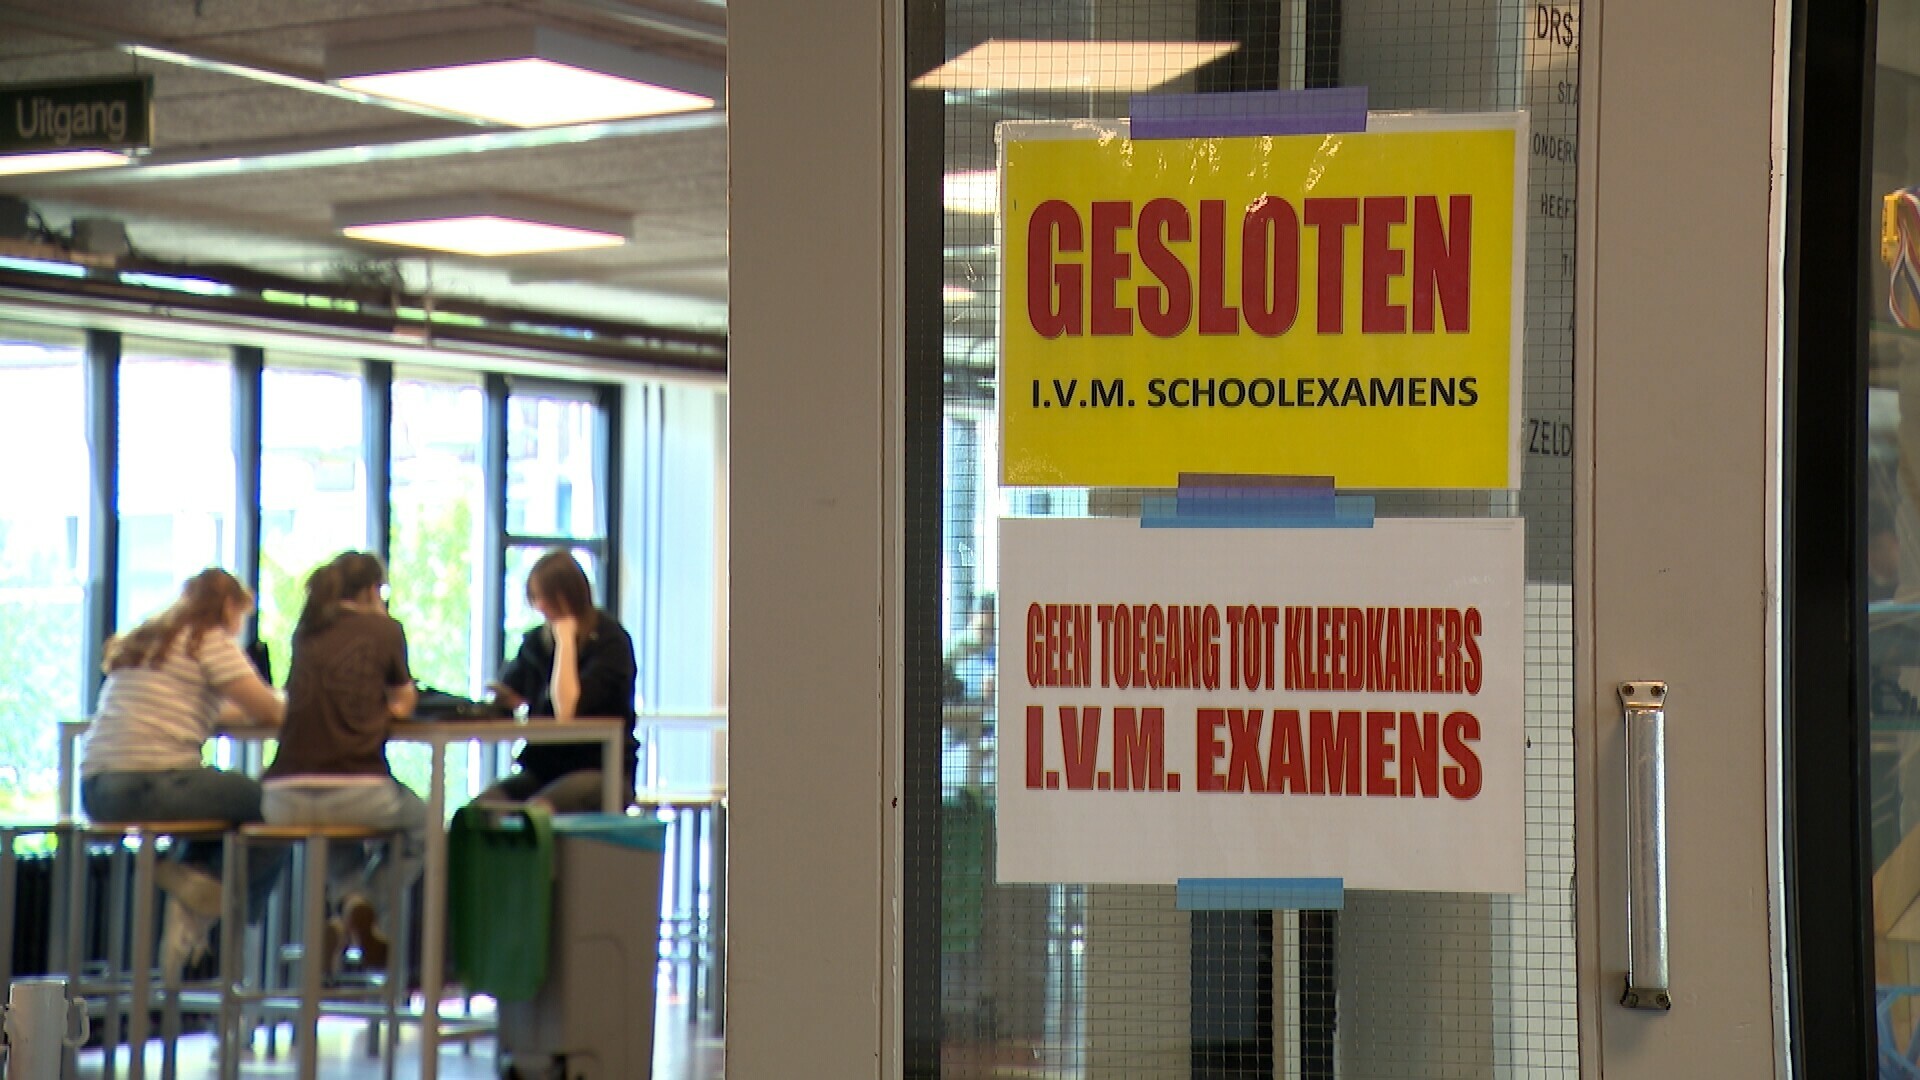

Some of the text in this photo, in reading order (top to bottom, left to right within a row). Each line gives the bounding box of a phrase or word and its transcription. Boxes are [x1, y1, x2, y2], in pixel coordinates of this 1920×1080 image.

[16, 96, 126, 145] Uitgang
[1027, 194, 1472, 338] GESLOTEN
[1032, 377, 1479, 409] I.V.M. SCHOOLEXAMENS
[1026, 602, 1483, 696] GEEN TOEGANG TOT KLEEDKAMERS
[1026, 705, 1483, 800] I.V.M. EXAMENS
